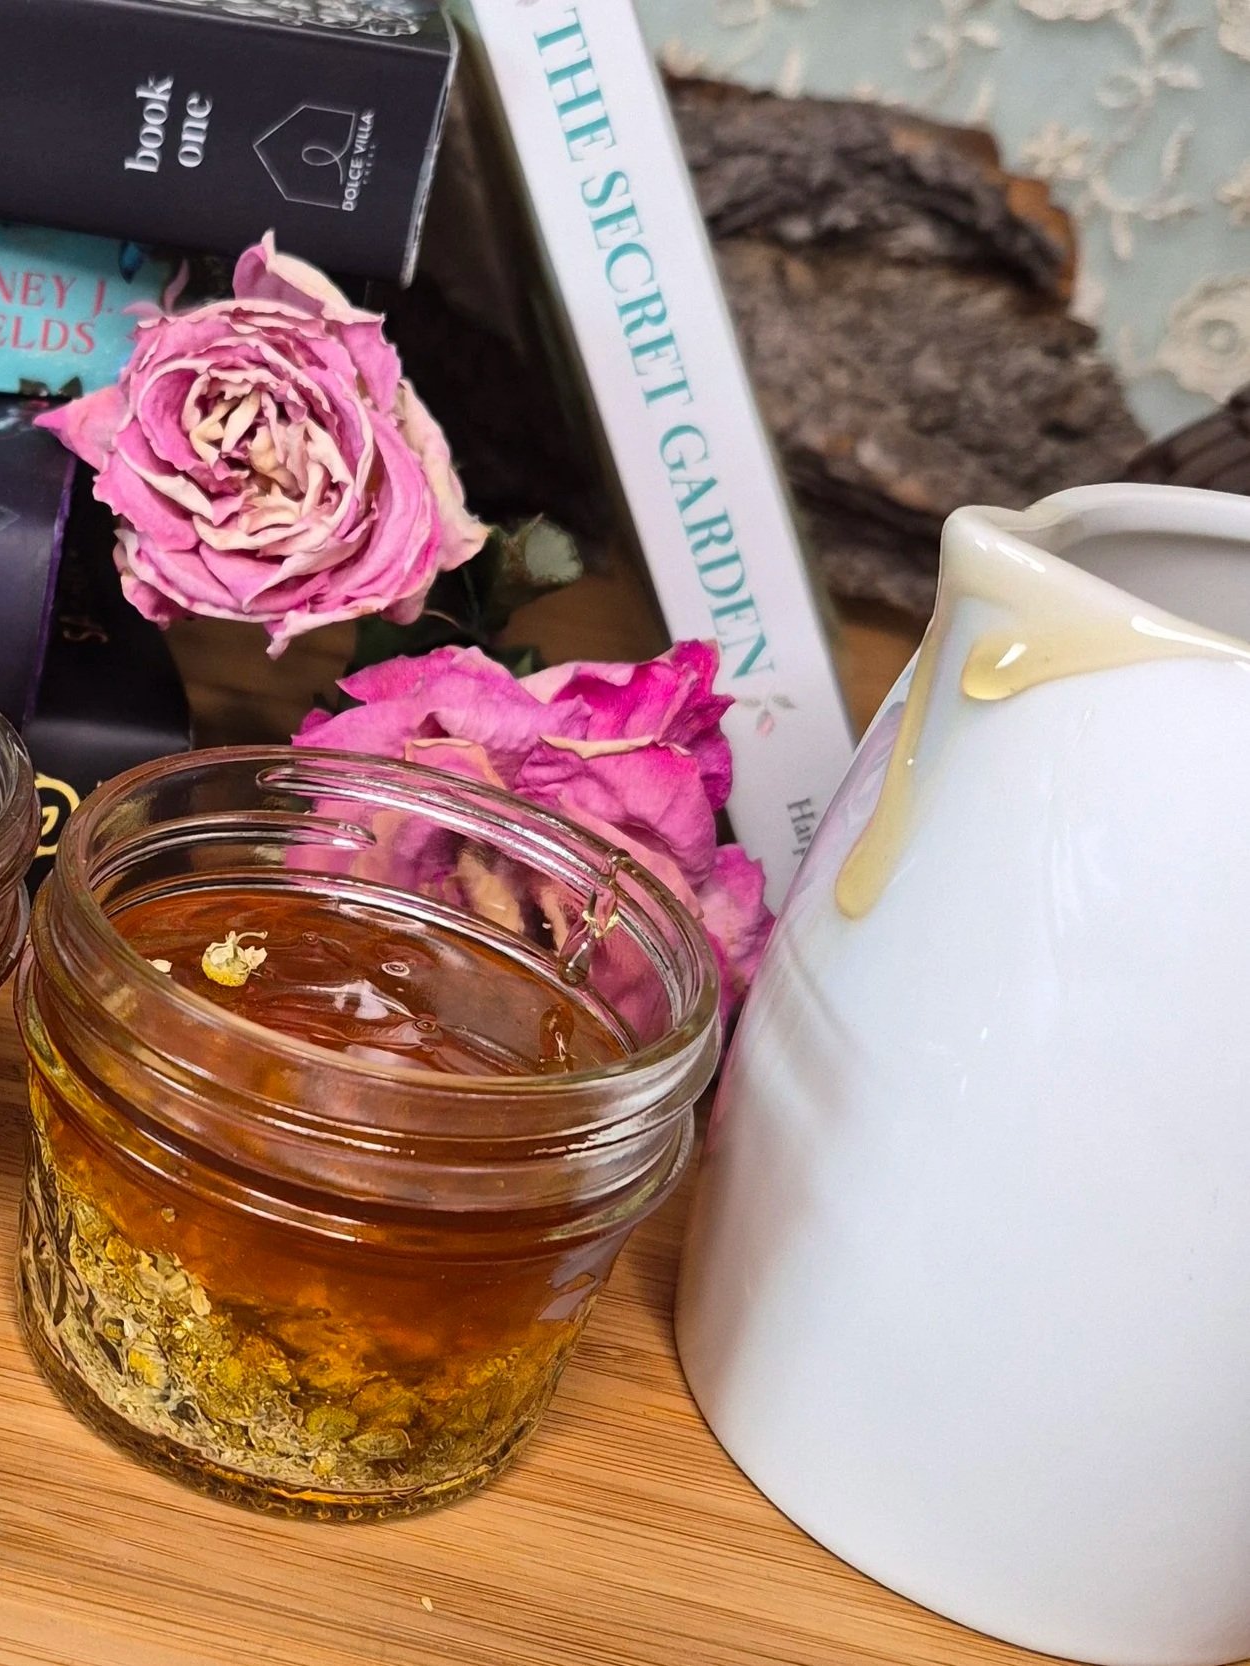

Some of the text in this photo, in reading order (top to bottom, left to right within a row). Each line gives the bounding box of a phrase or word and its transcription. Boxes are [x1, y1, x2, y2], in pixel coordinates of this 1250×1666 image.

[124, 74, 174, 173] book
[178, 91, 213, 168] one
[342, 158, 363, 211] DOLCE
[353, 109, 375, 155] VILLA
[534, 7, 775, 679] THE SECRET GARDEN
